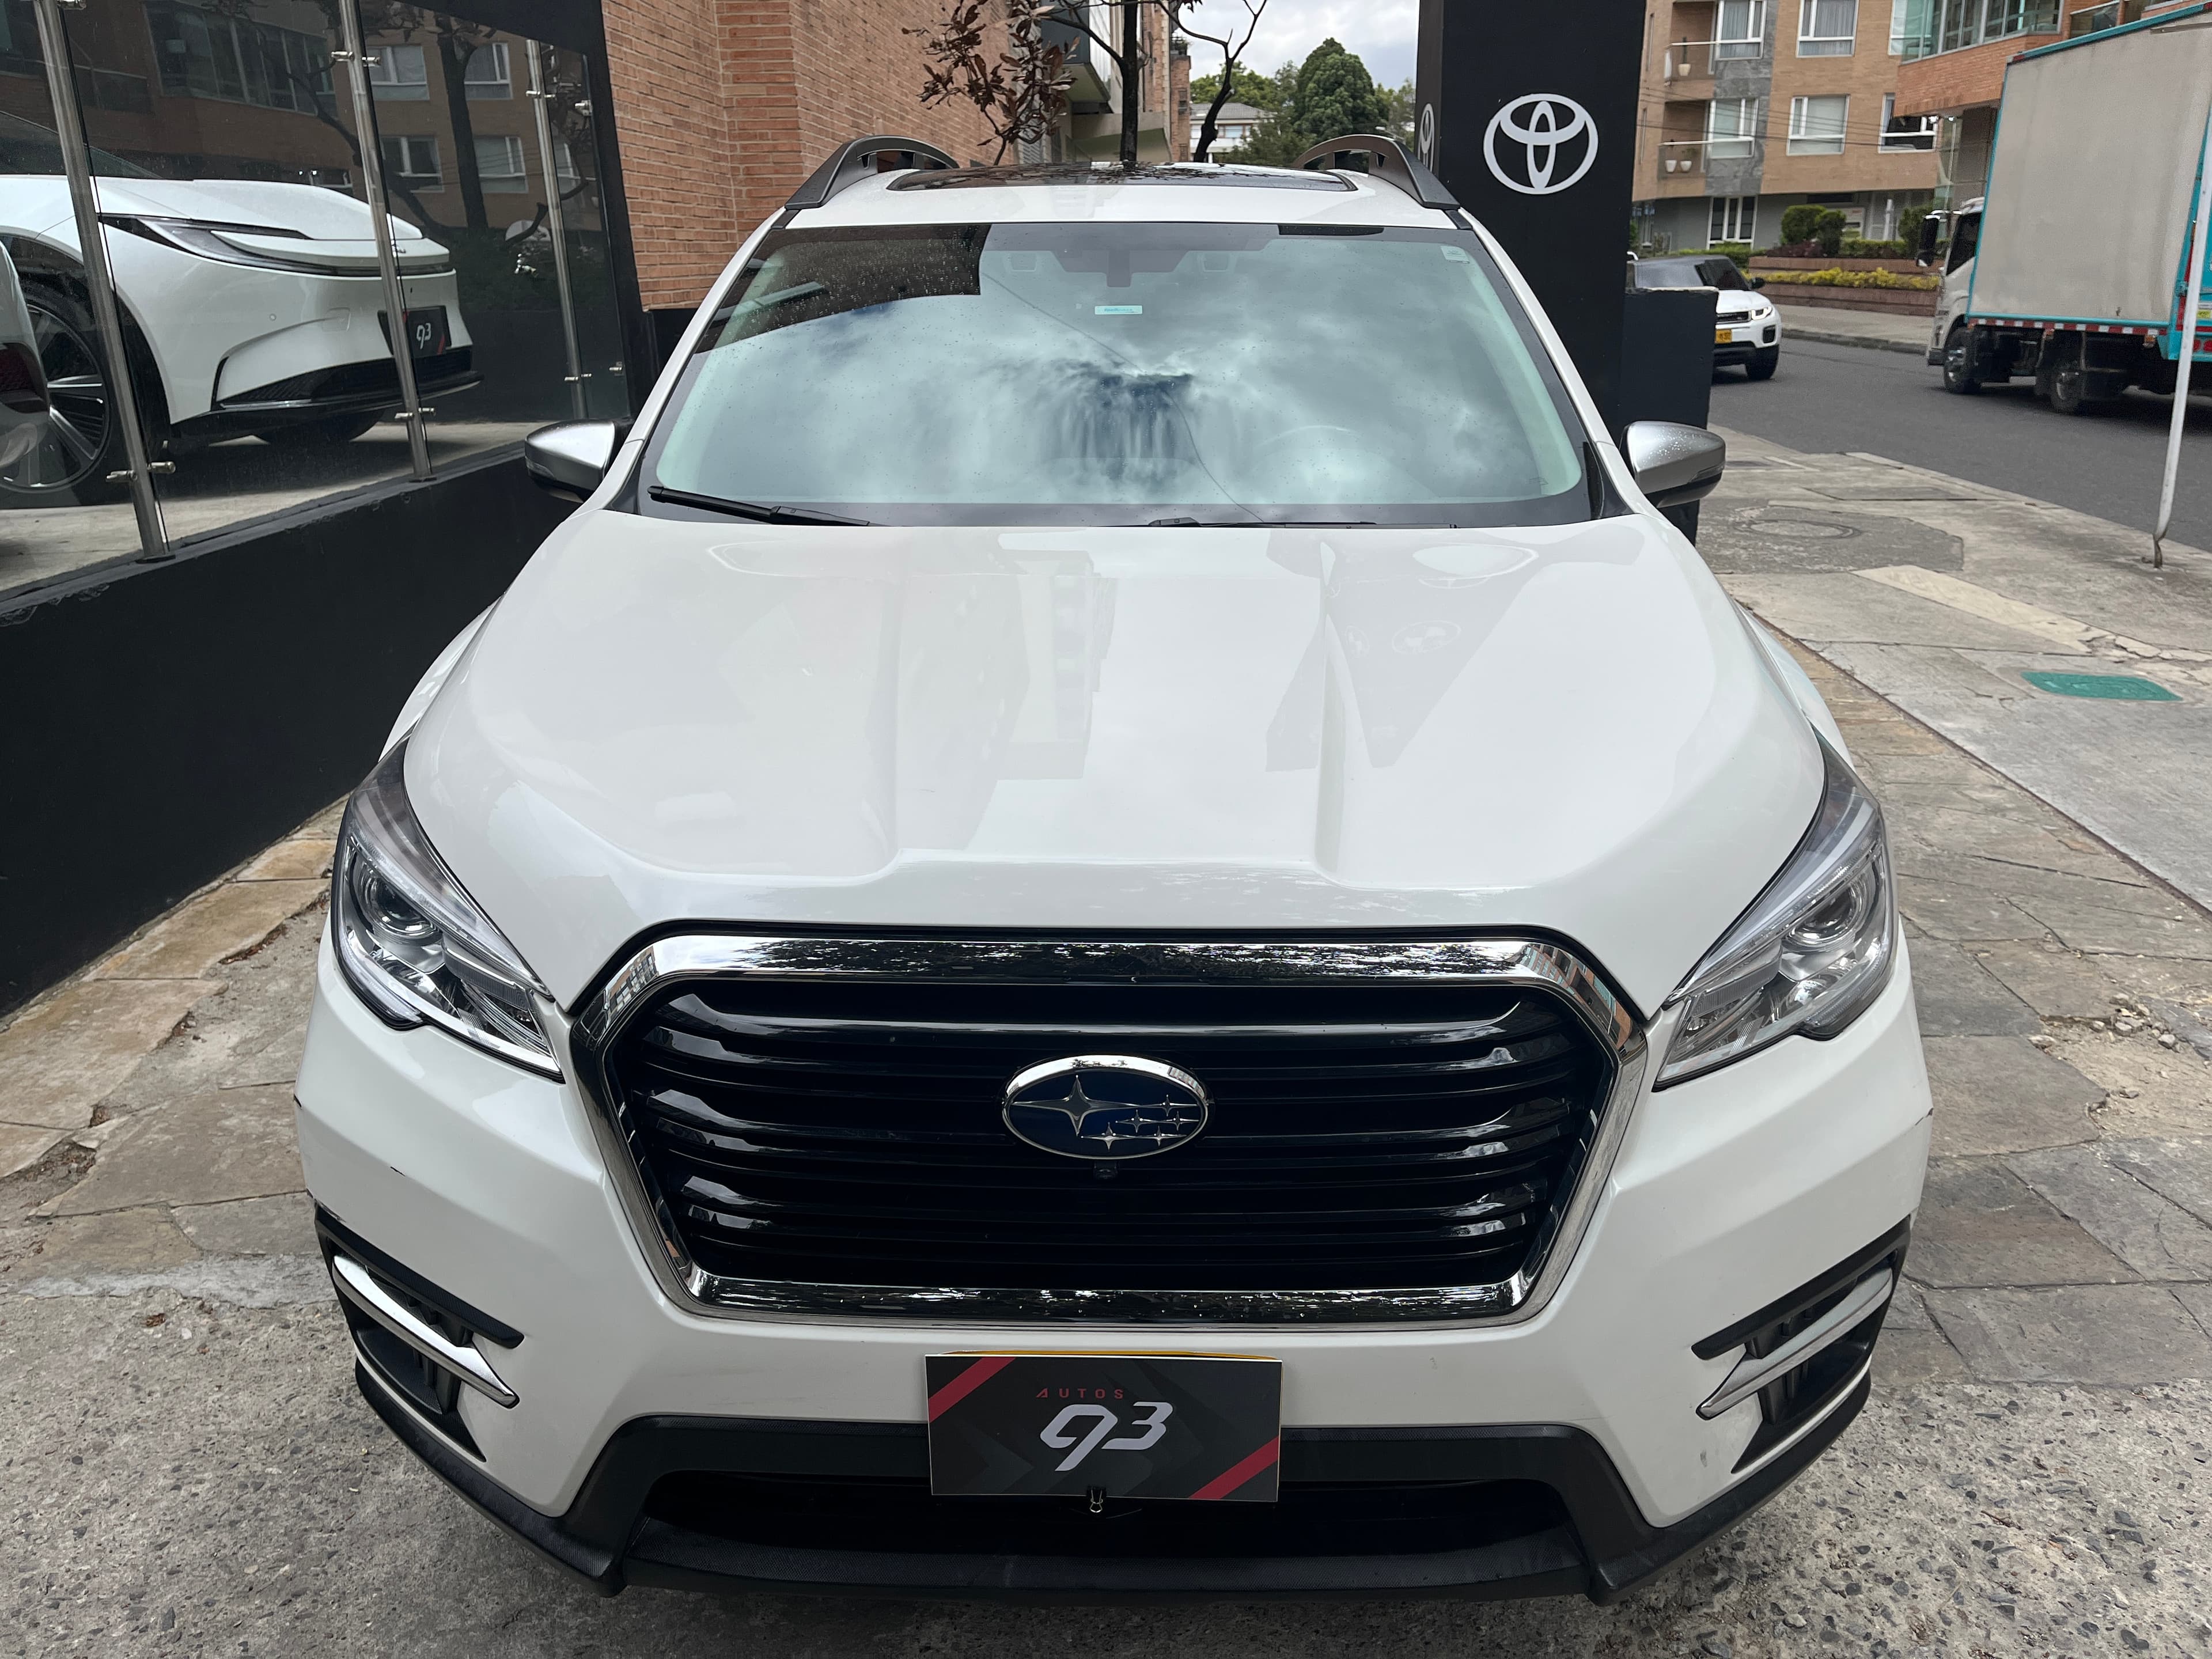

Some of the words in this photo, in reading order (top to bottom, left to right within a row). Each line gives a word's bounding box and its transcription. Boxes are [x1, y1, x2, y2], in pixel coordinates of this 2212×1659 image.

[416, 323, 431, 350] 93
[1036, 1388, 1124, 1399] AUTOS
[1040, 1401, 1173, 1472] 93
